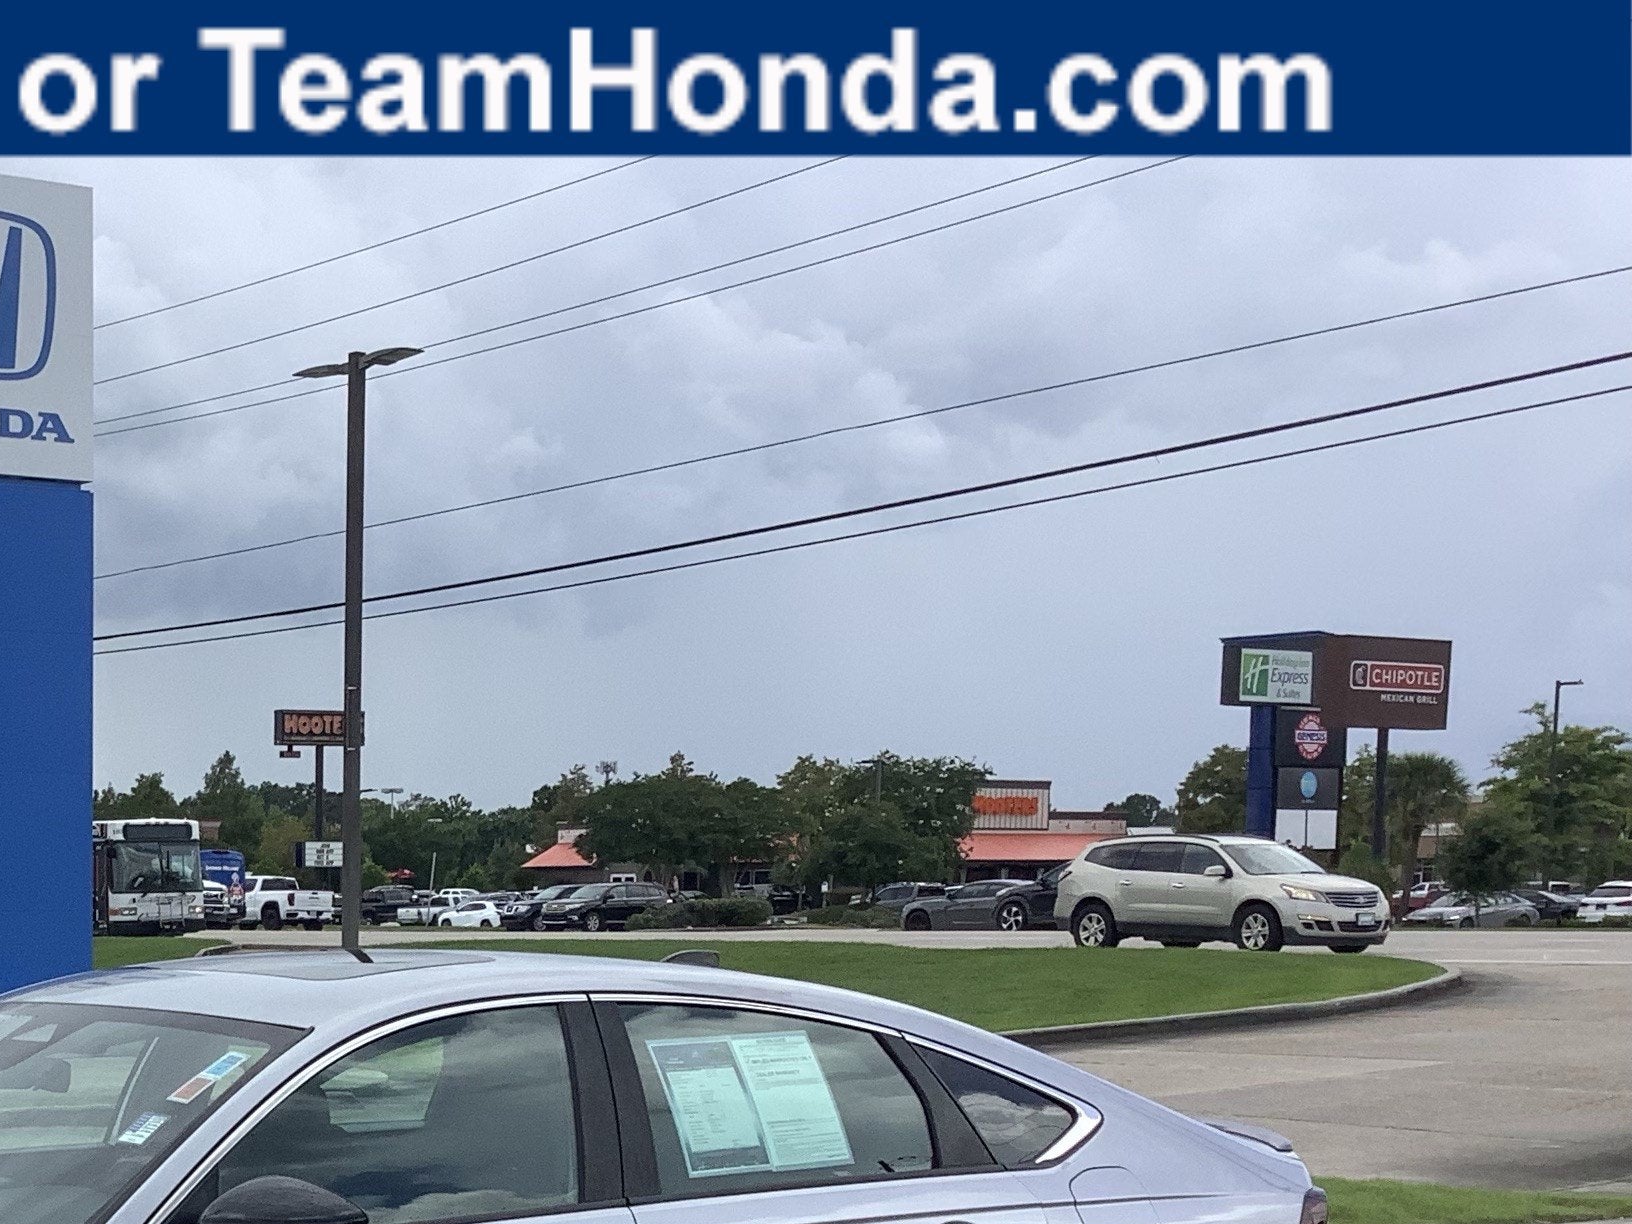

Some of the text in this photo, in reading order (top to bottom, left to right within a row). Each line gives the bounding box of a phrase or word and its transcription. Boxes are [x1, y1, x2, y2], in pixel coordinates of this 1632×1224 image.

[1270, 667, 1310, 686] Express
[1372, 668, 1441, 686] CHIPOTLE
[1380, 693, 1438, 705] MEXICAN GRILL
[283, 714, 347, 735] HOOTE
